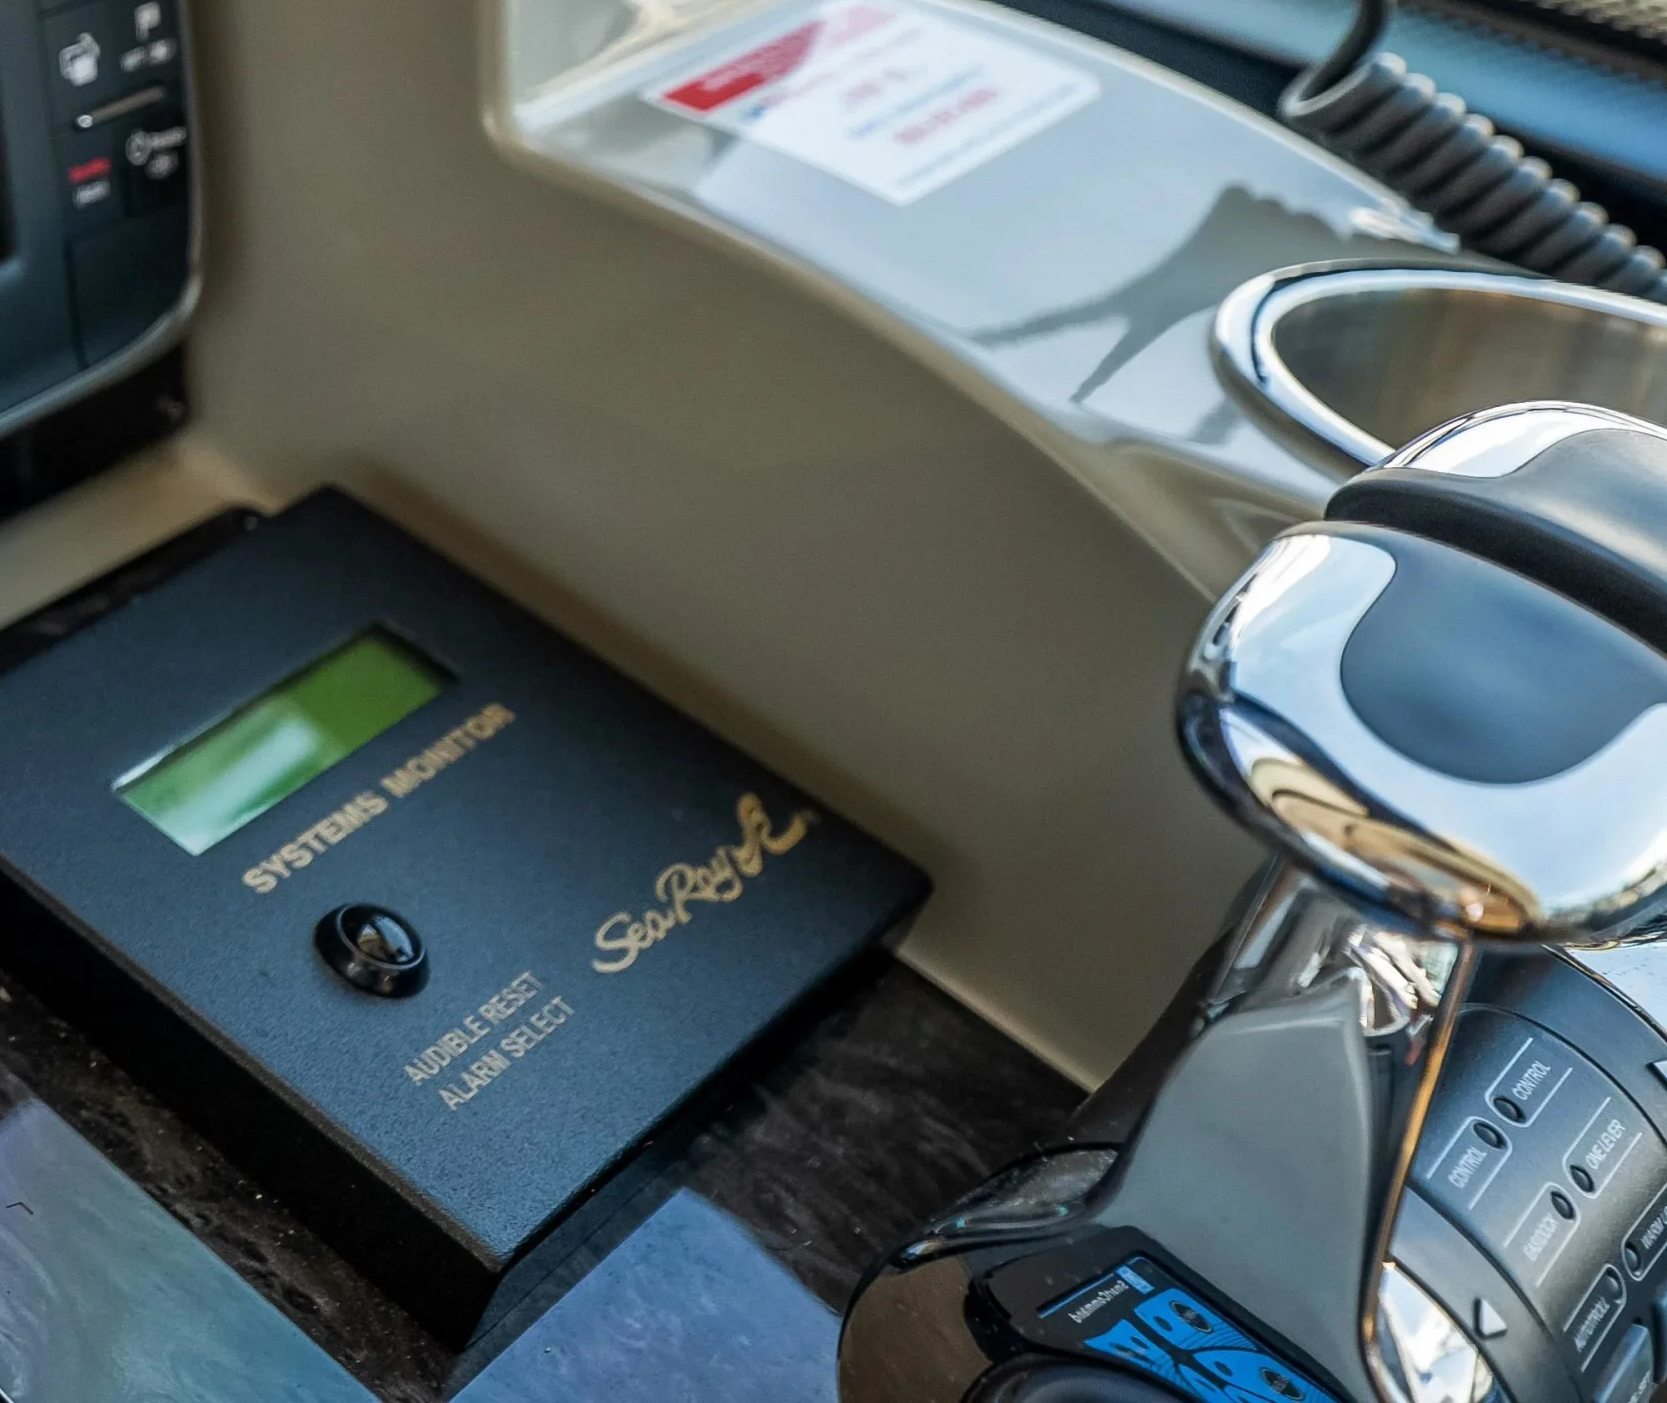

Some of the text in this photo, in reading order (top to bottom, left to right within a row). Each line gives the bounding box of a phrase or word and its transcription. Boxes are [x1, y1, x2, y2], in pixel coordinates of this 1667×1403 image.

[241, 702, 516, 894] SYSTEMS MONITOR
[404, 971, 543, 1086] AUDIBLE RESET
[438, 995, 575, 1111] ALARM SELECT
[1512, 1060, 1551, 1100] CONTROL
[1448, 1146, 1487, 1188] CONTROL
